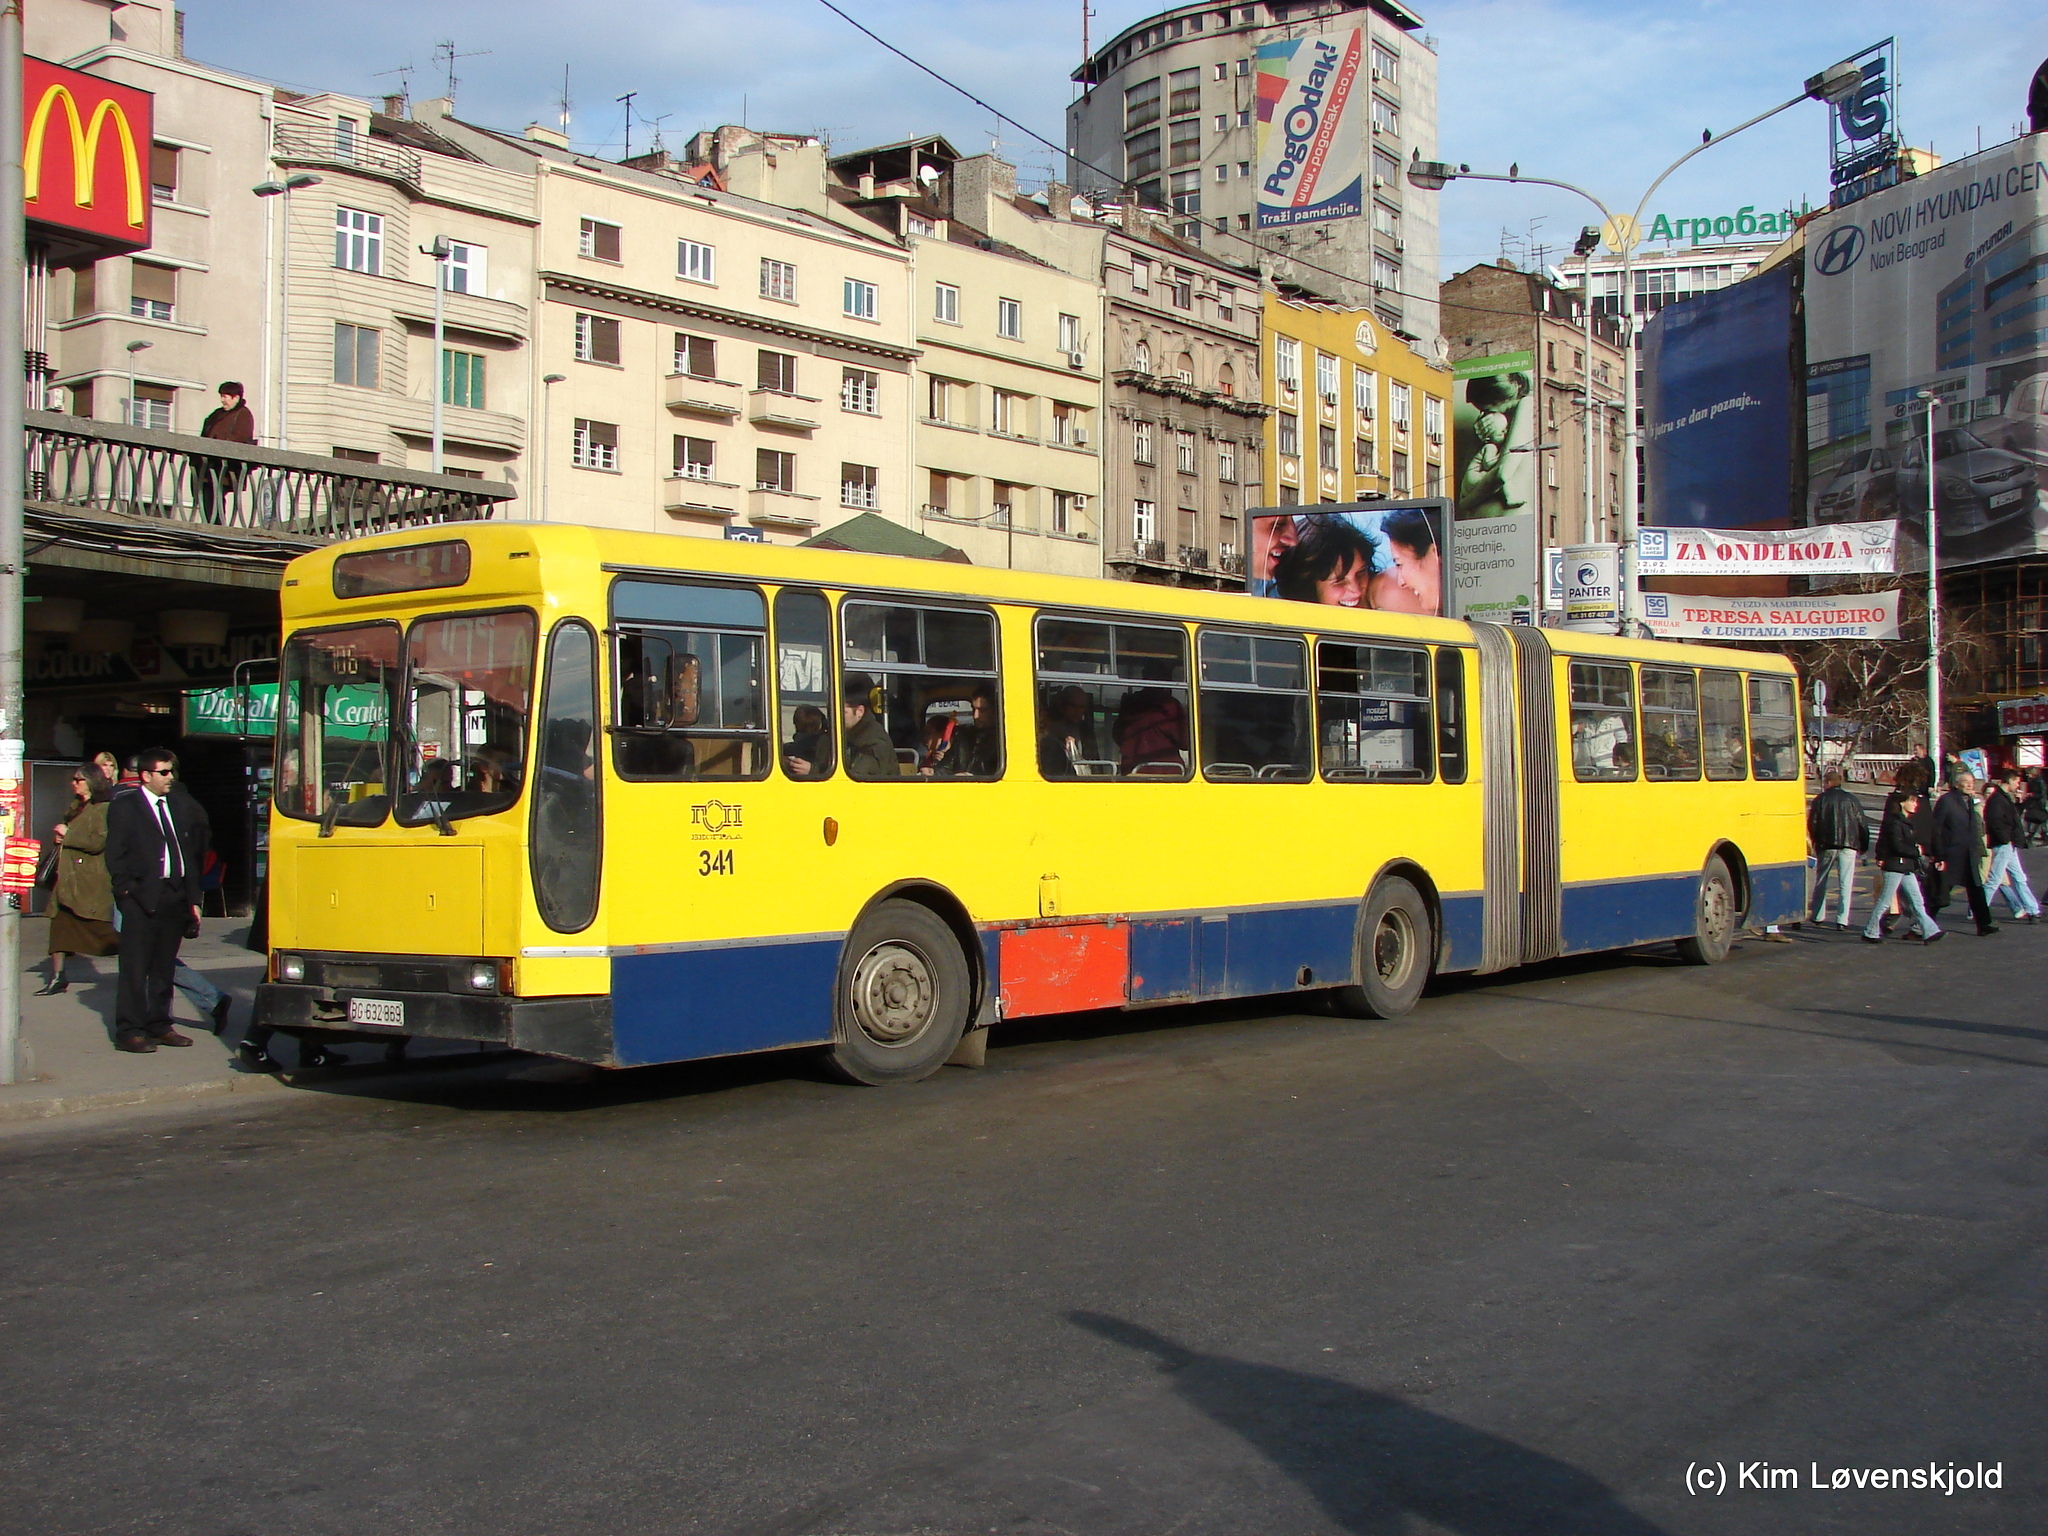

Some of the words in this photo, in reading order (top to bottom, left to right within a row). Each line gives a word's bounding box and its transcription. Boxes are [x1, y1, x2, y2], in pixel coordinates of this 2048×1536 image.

[1297, 50, 1360, 204] www.pogodak.co.yu
[1261, 211, 1291, 225] Traži
[1294, 203, 1359, 223] pametnije.
[1871, 205, 1912, 245] NOVI
[1916, 174, 2000, 228] HYUNDAI
[1648, 202, 1808, 246] Агробан
[1976, 221, 2013, 259] HYUNDAI
[1870, 251, 1894, 271] Novi
[1897, 228, 1945, 262] Beograd
[1676, 417, 1687, 429] se
[1688, 408, 1708, 424] dan
[1642, 534, 1662, 545] SC
[1454, 541, 1506, 557] ajvrednije,
[1676, 543, 1707, 561] ZA
[1716, 541, 1853, 561] ONDEKOZA
[1859, 547, 1892, 556] TOYOTA
[1454, 558, 1515, 574] siguravamo
[1455, 576, 1482, 588] IVOT.
[1569, 586, 1611, 598] PANTER
[1465, 601, 1518, 612] MERKUR
[1648, 598, 1665, 608] SC
[1731, 600, 1768, 608] ZVEZDA
[1682, 608, 1764, 624] TERESA
[1769, 608, 1886, 625] SALGUEIRO
[1701, 626, 1712, 636] &
[1716, 626, 1787, 637] LUSITANIA
[1792, 626, 1867, 637] ENSEMBLE
[698, 849, 734, 877] 341
